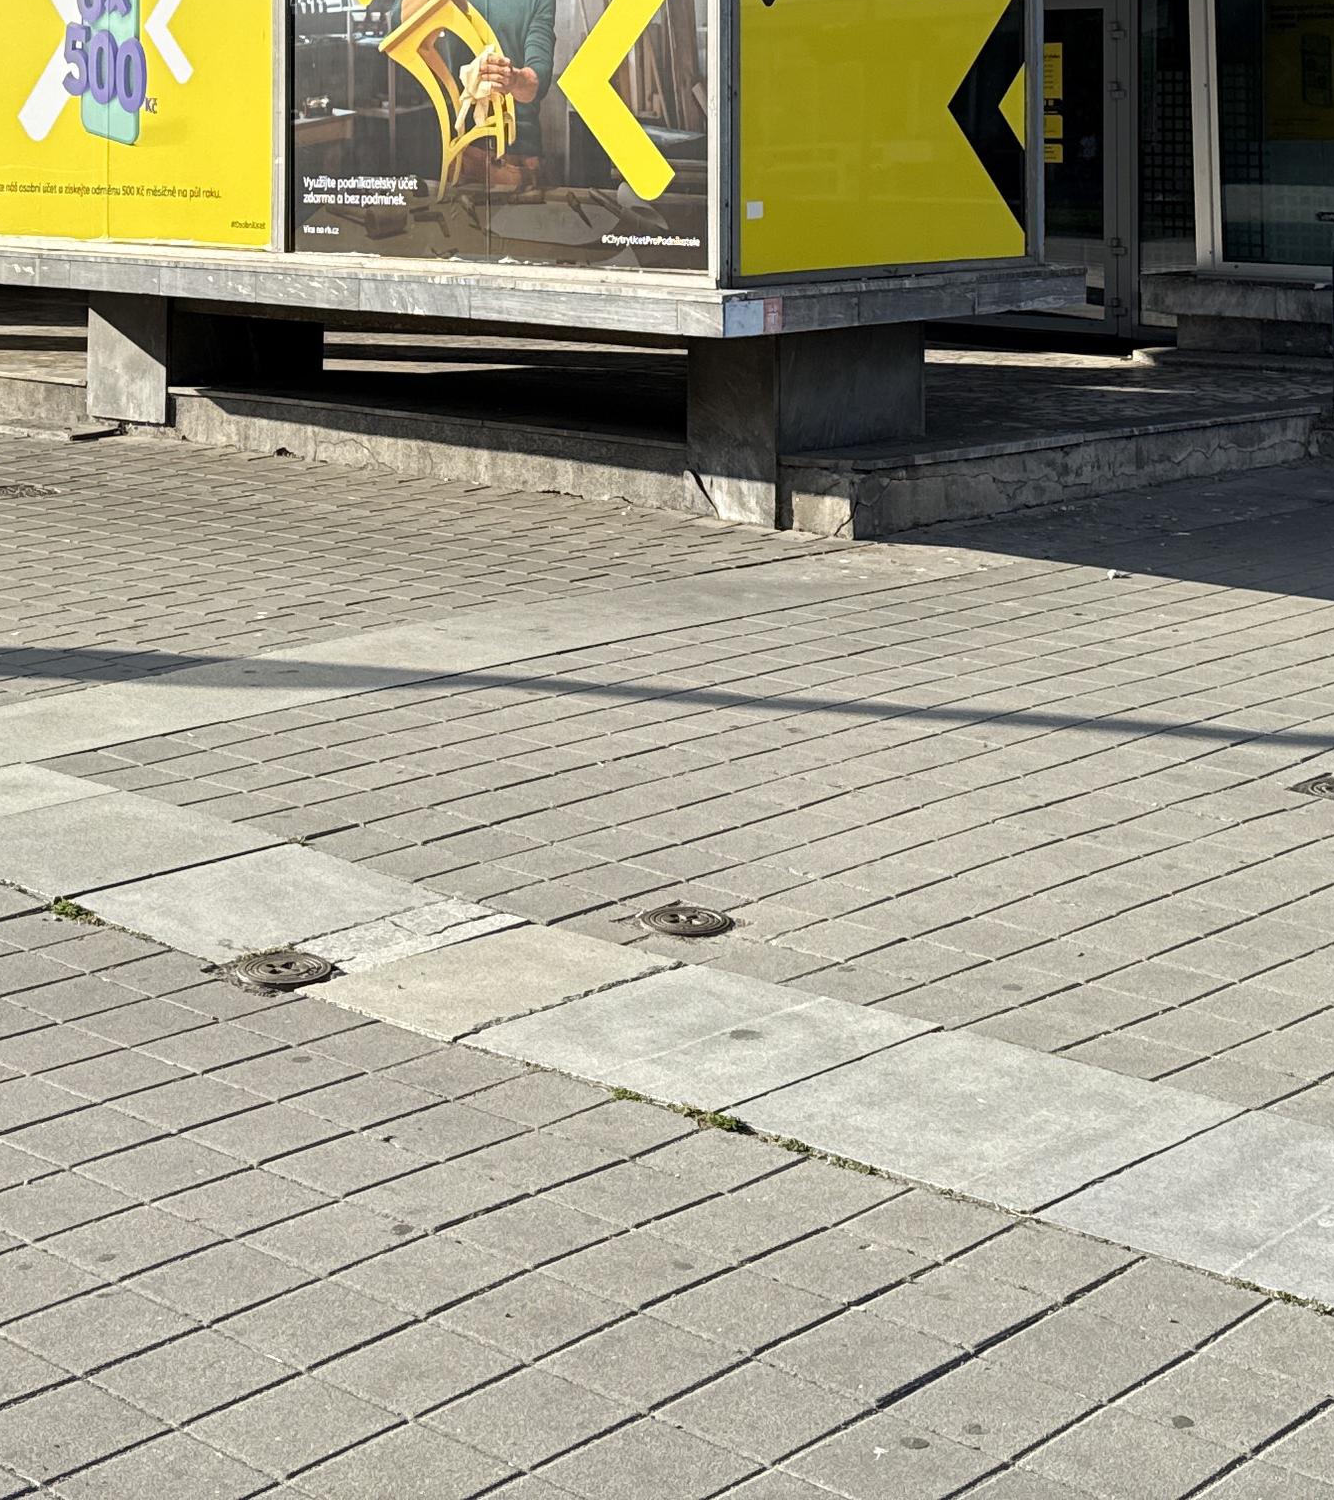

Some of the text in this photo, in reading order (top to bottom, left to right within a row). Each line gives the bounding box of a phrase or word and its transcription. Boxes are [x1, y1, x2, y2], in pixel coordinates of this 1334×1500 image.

[62, 21, 158, 115] 500 Kč
[6, 181, 18, 192] náš
[19, 182, 41, 193] osobní
[42, 182, 57, 194] účet
[65, 183, 90, 197] získejte
[91, 185, 121, 196] odměnu
[122, 185, 135, 196] 500
[136, 185, 145, 196] Kč
[146, 185, 176, 198] měsíčně
[178, 188, 187, 198] na
[189, 187, 201, 202] půl
[303, 175, 418, 192] Využijte podnikatelský účet
[303, 191, 407, 207] zdarma a bez podmínek.
